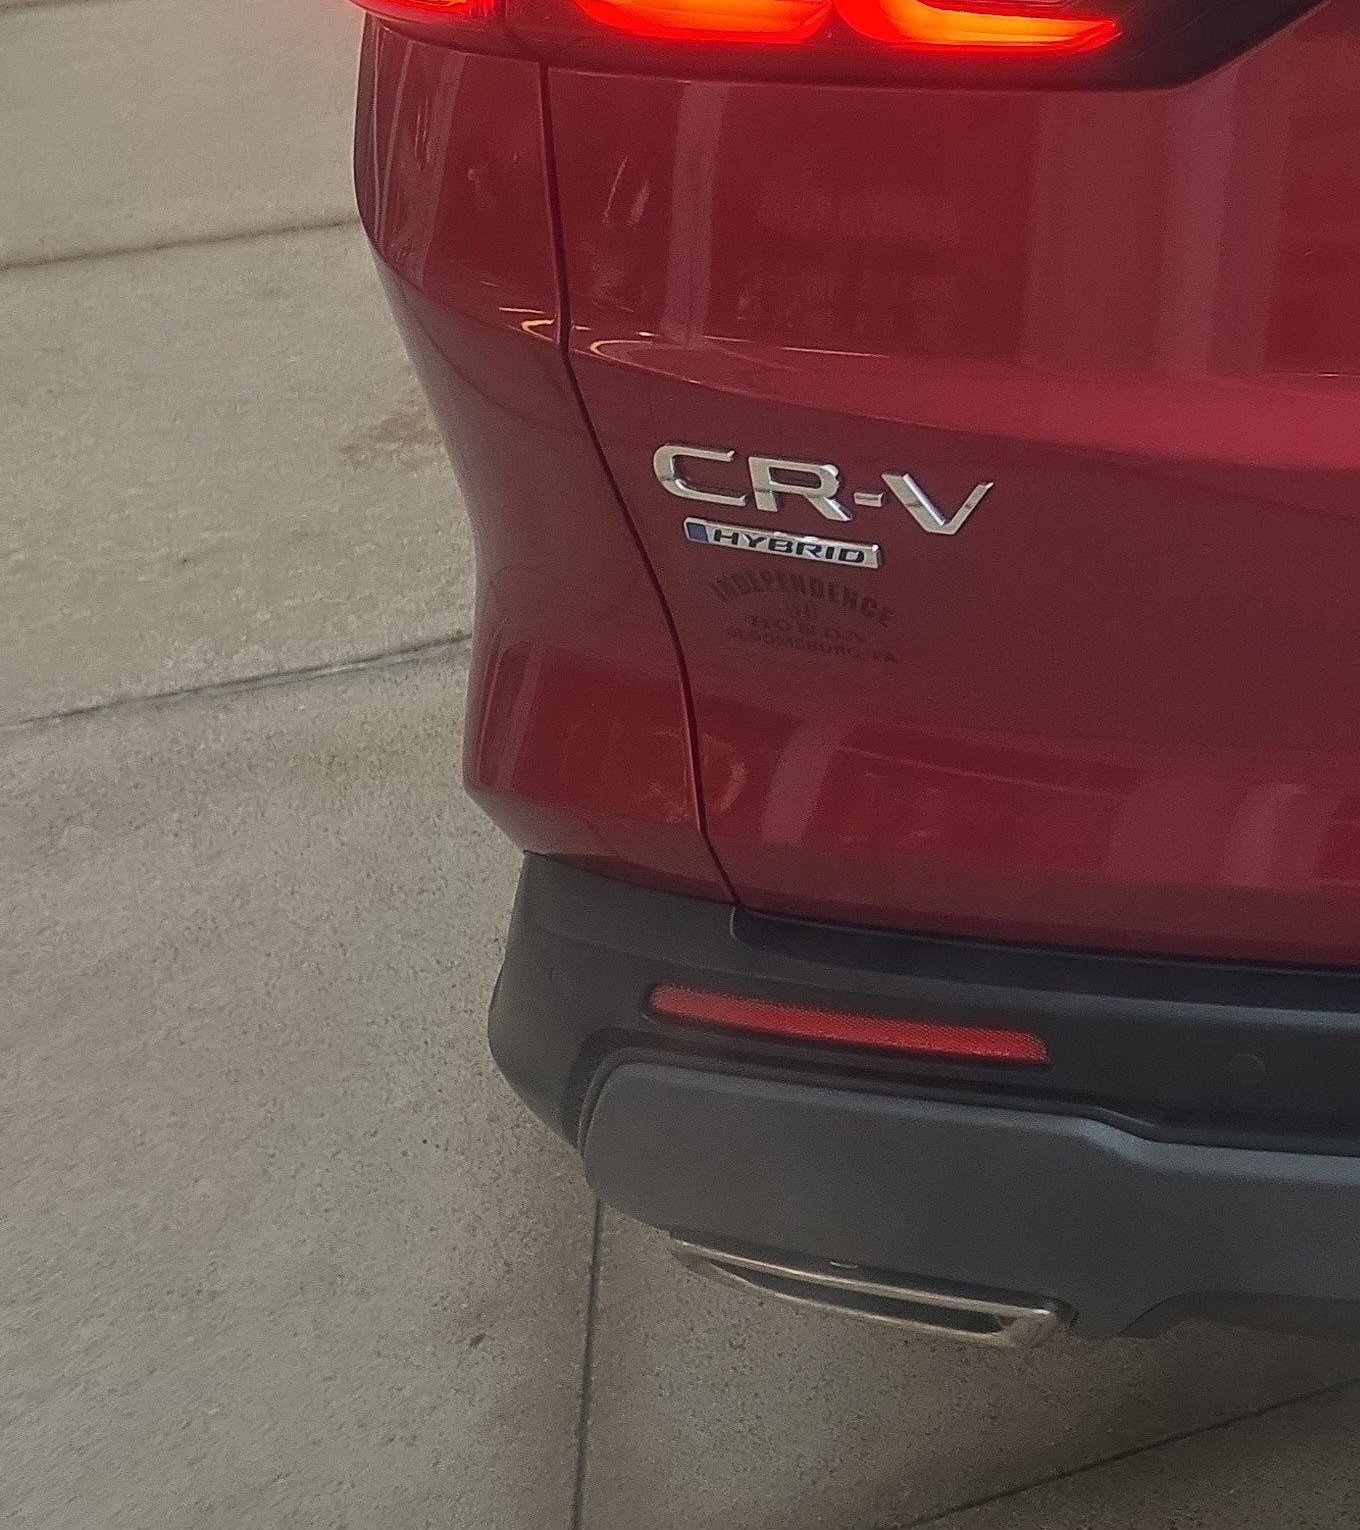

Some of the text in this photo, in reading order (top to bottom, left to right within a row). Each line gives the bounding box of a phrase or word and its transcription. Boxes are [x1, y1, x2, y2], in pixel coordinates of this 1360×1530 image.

[653, 443, 995, 535] CR-V
[714, 529, 866, 565] HYBRID
[708, 569, 895, 627] INDEPENDENCE
[748, 614, 867, 644] HONDA
